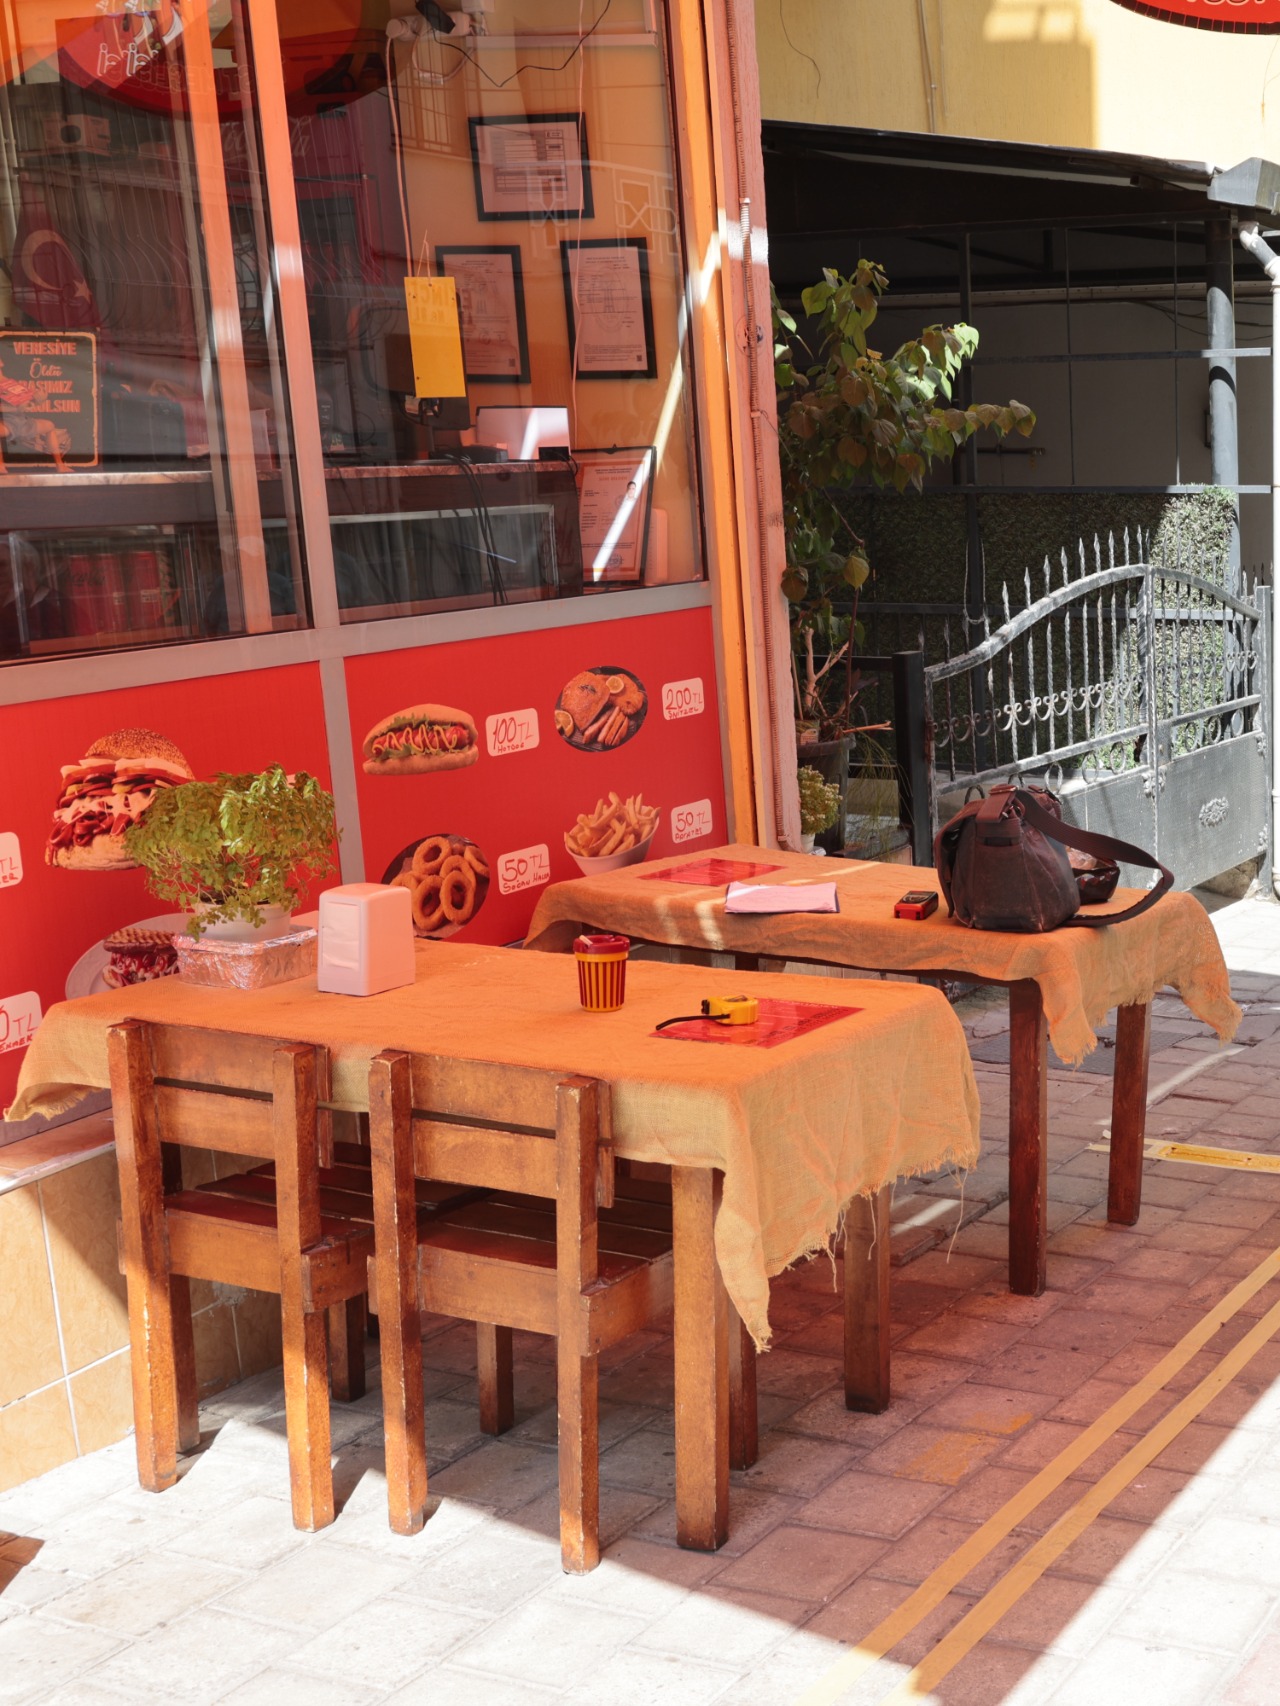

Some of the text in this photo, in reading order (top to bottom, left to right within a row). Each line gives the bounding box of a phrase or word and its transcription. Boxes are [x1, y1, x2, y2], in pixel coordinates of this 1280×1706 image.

[13, 339, 77, 355] VERESİYE
[665, 687, 704, 710] 200 TL
[492, 717, 534, 751] 100 TL
[675, 810, 712, 833] 50 TL
[502, 853, 551, 883] 50 TL
[12, 1012, 39, 1038] TL
